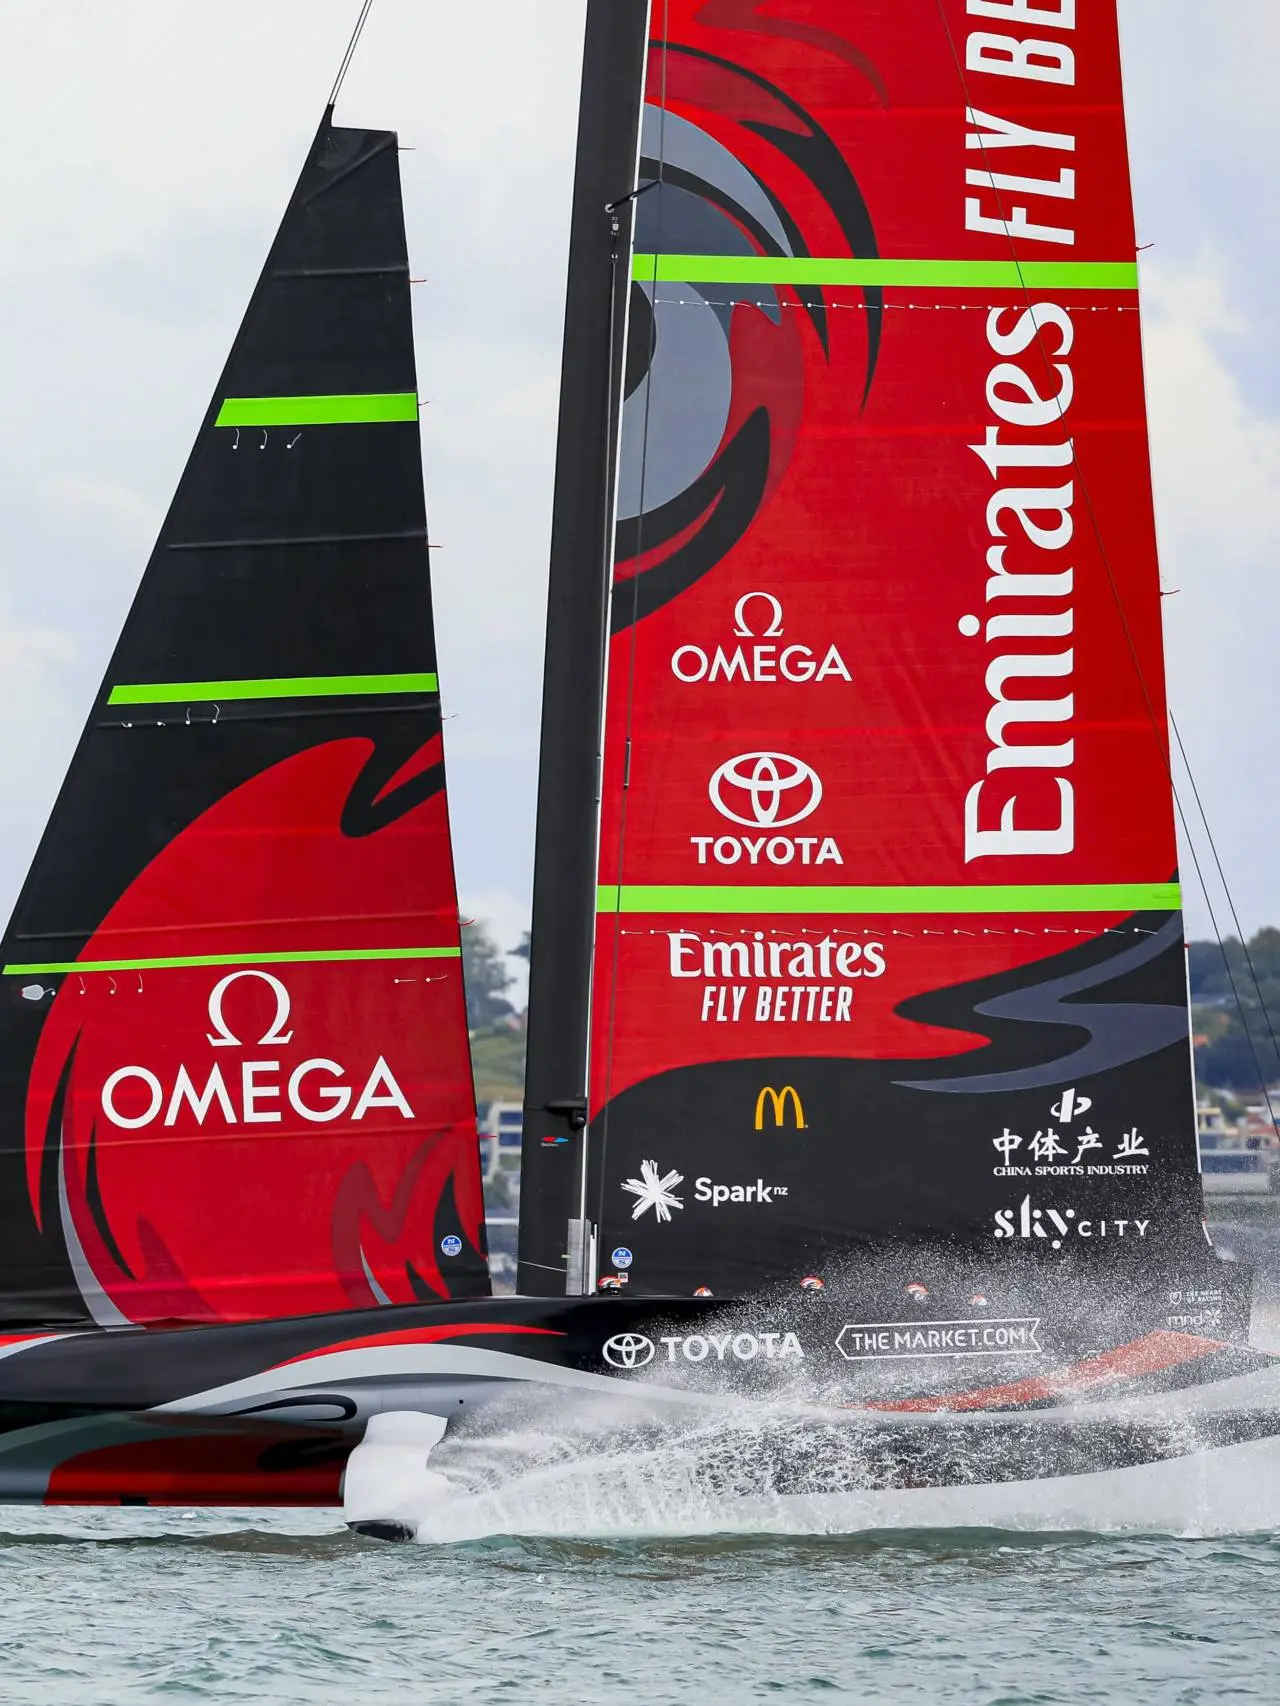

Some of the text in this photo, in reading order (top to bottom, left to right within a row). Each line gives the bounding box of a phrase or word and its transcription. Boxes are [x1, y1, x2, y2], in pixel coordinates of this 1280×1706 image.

[965, 106, 1076, 245] FLY
[958, 302, 1075, 863] Emirates
[671, 644, 853, 682] OMEGA
[690, 836, 844, 865] TOYOTA
[667, 931, 887, 978] Emirates
[701, 986, 854, 1022] FLY BETTER
[101, 1055, 416, 1129] OMEGA
[992, 1126, 1149, 1166] 中体产业
[993, 1165, 1149, 1176] CHINA SPORTS INDUSTRY
[660, 1332, 805, 1362] TOYOTA
